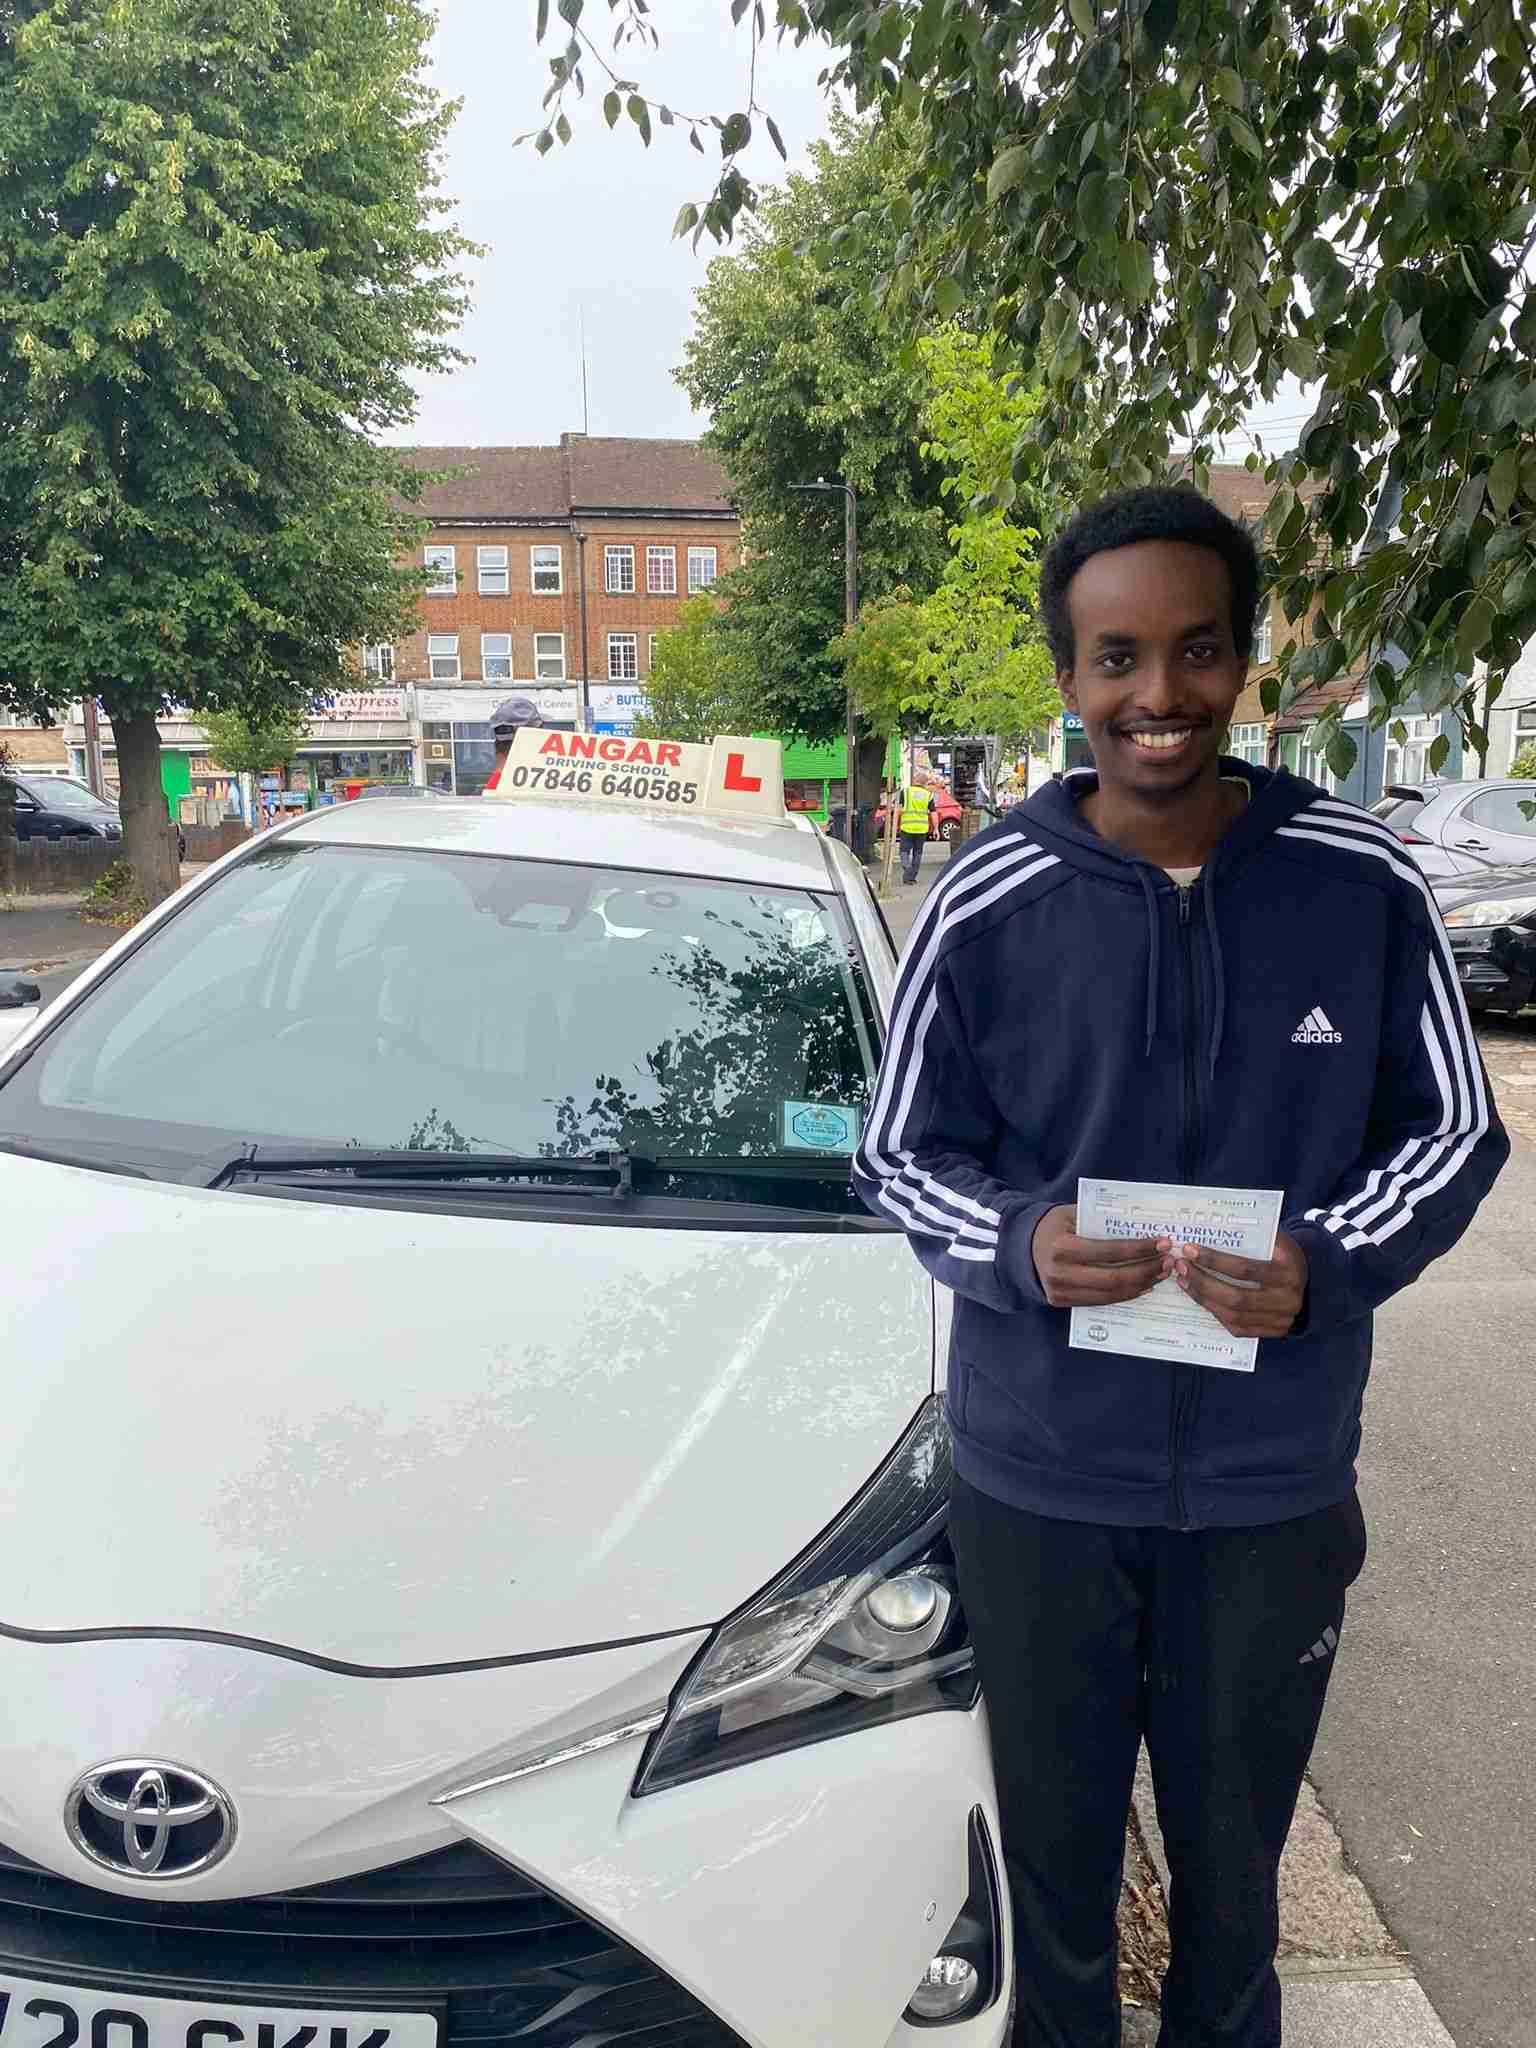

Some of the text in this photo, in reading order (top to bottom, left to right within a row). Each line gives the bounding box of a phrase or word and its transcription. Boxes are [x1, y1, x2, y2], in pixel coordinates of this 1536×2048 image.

[340, 697, 400, 711] express
[539, 733, 683, 767] ANGAR
[545, 757, 670, 777] DRIVING SCHOOL
[724, 753, 762, 792] L
[512, 766, 698, 804] 07846 640585
[1291, 1029, 1343, 1044] adidas
[1105, 1216, 1244, 1239] PRACTICAL DRIVING
[1106, 1227, 1132, 1237] TEST
[1168, 1234, 1241, 1248] CERTIFICATE
